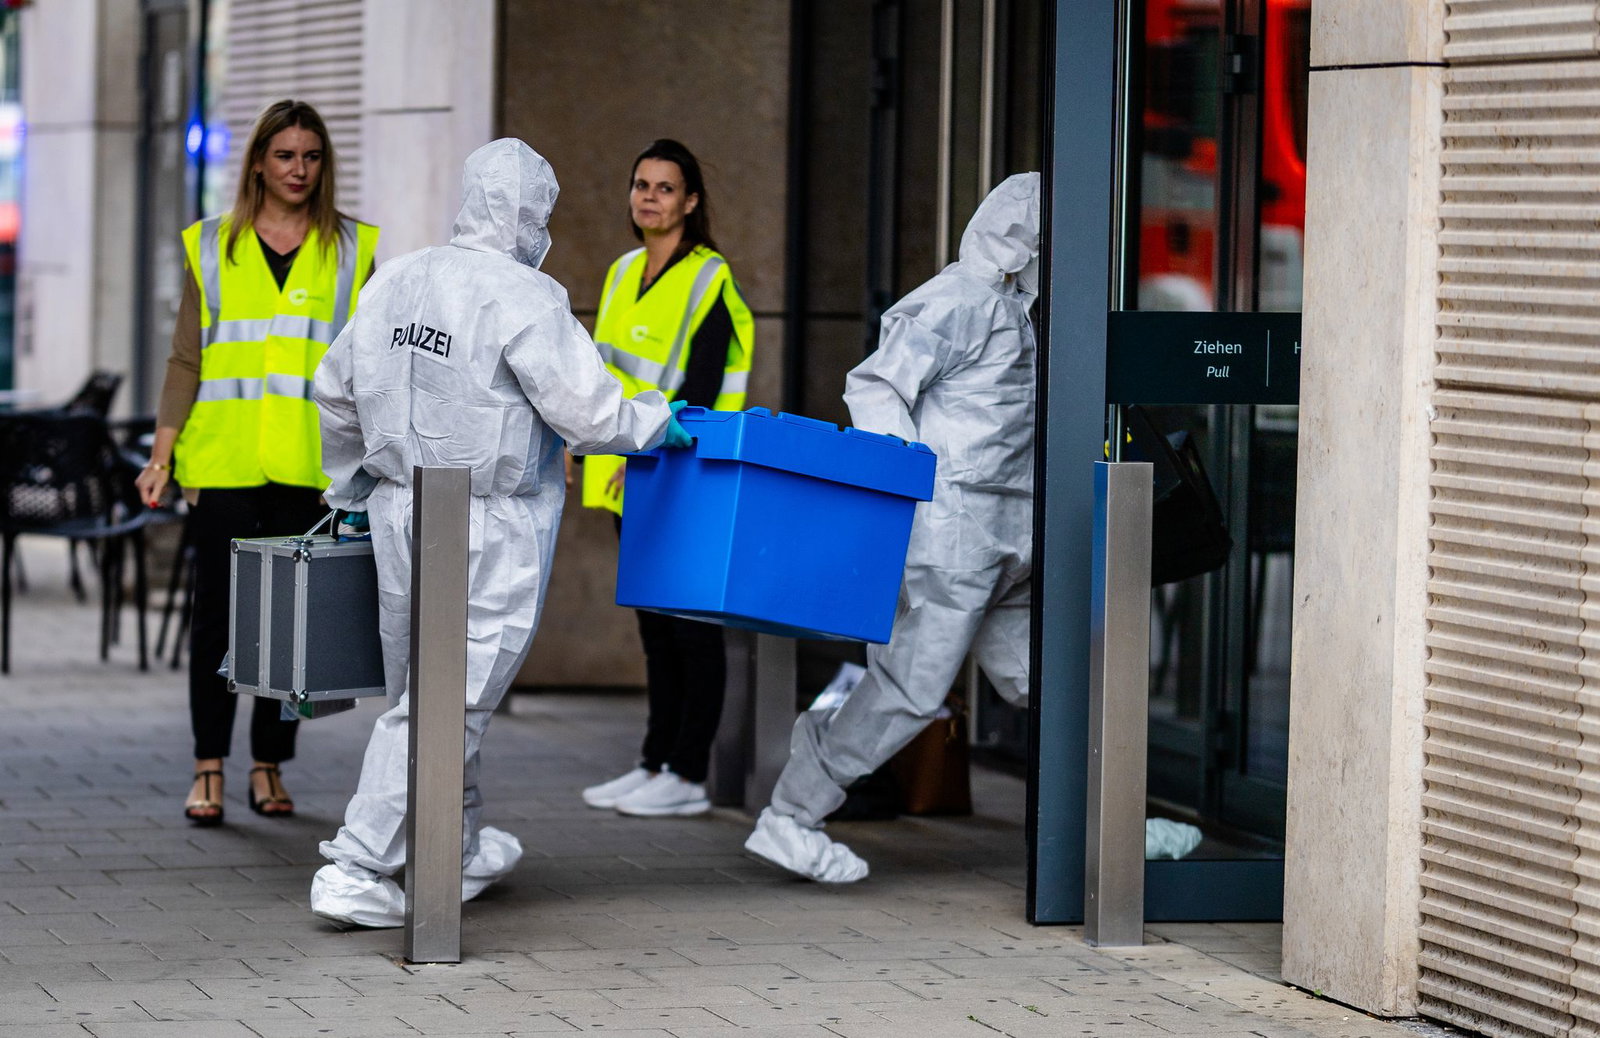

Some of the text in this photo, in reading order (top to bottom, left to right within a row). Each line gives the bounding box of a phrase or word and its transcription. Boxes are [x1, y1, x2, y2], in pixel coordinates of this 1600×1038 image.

[390, 323, 452, 358] POLIZEI
[1193, 340, 1242, 354] Ziehen
[1206, 366, 1230, 378] Pull
